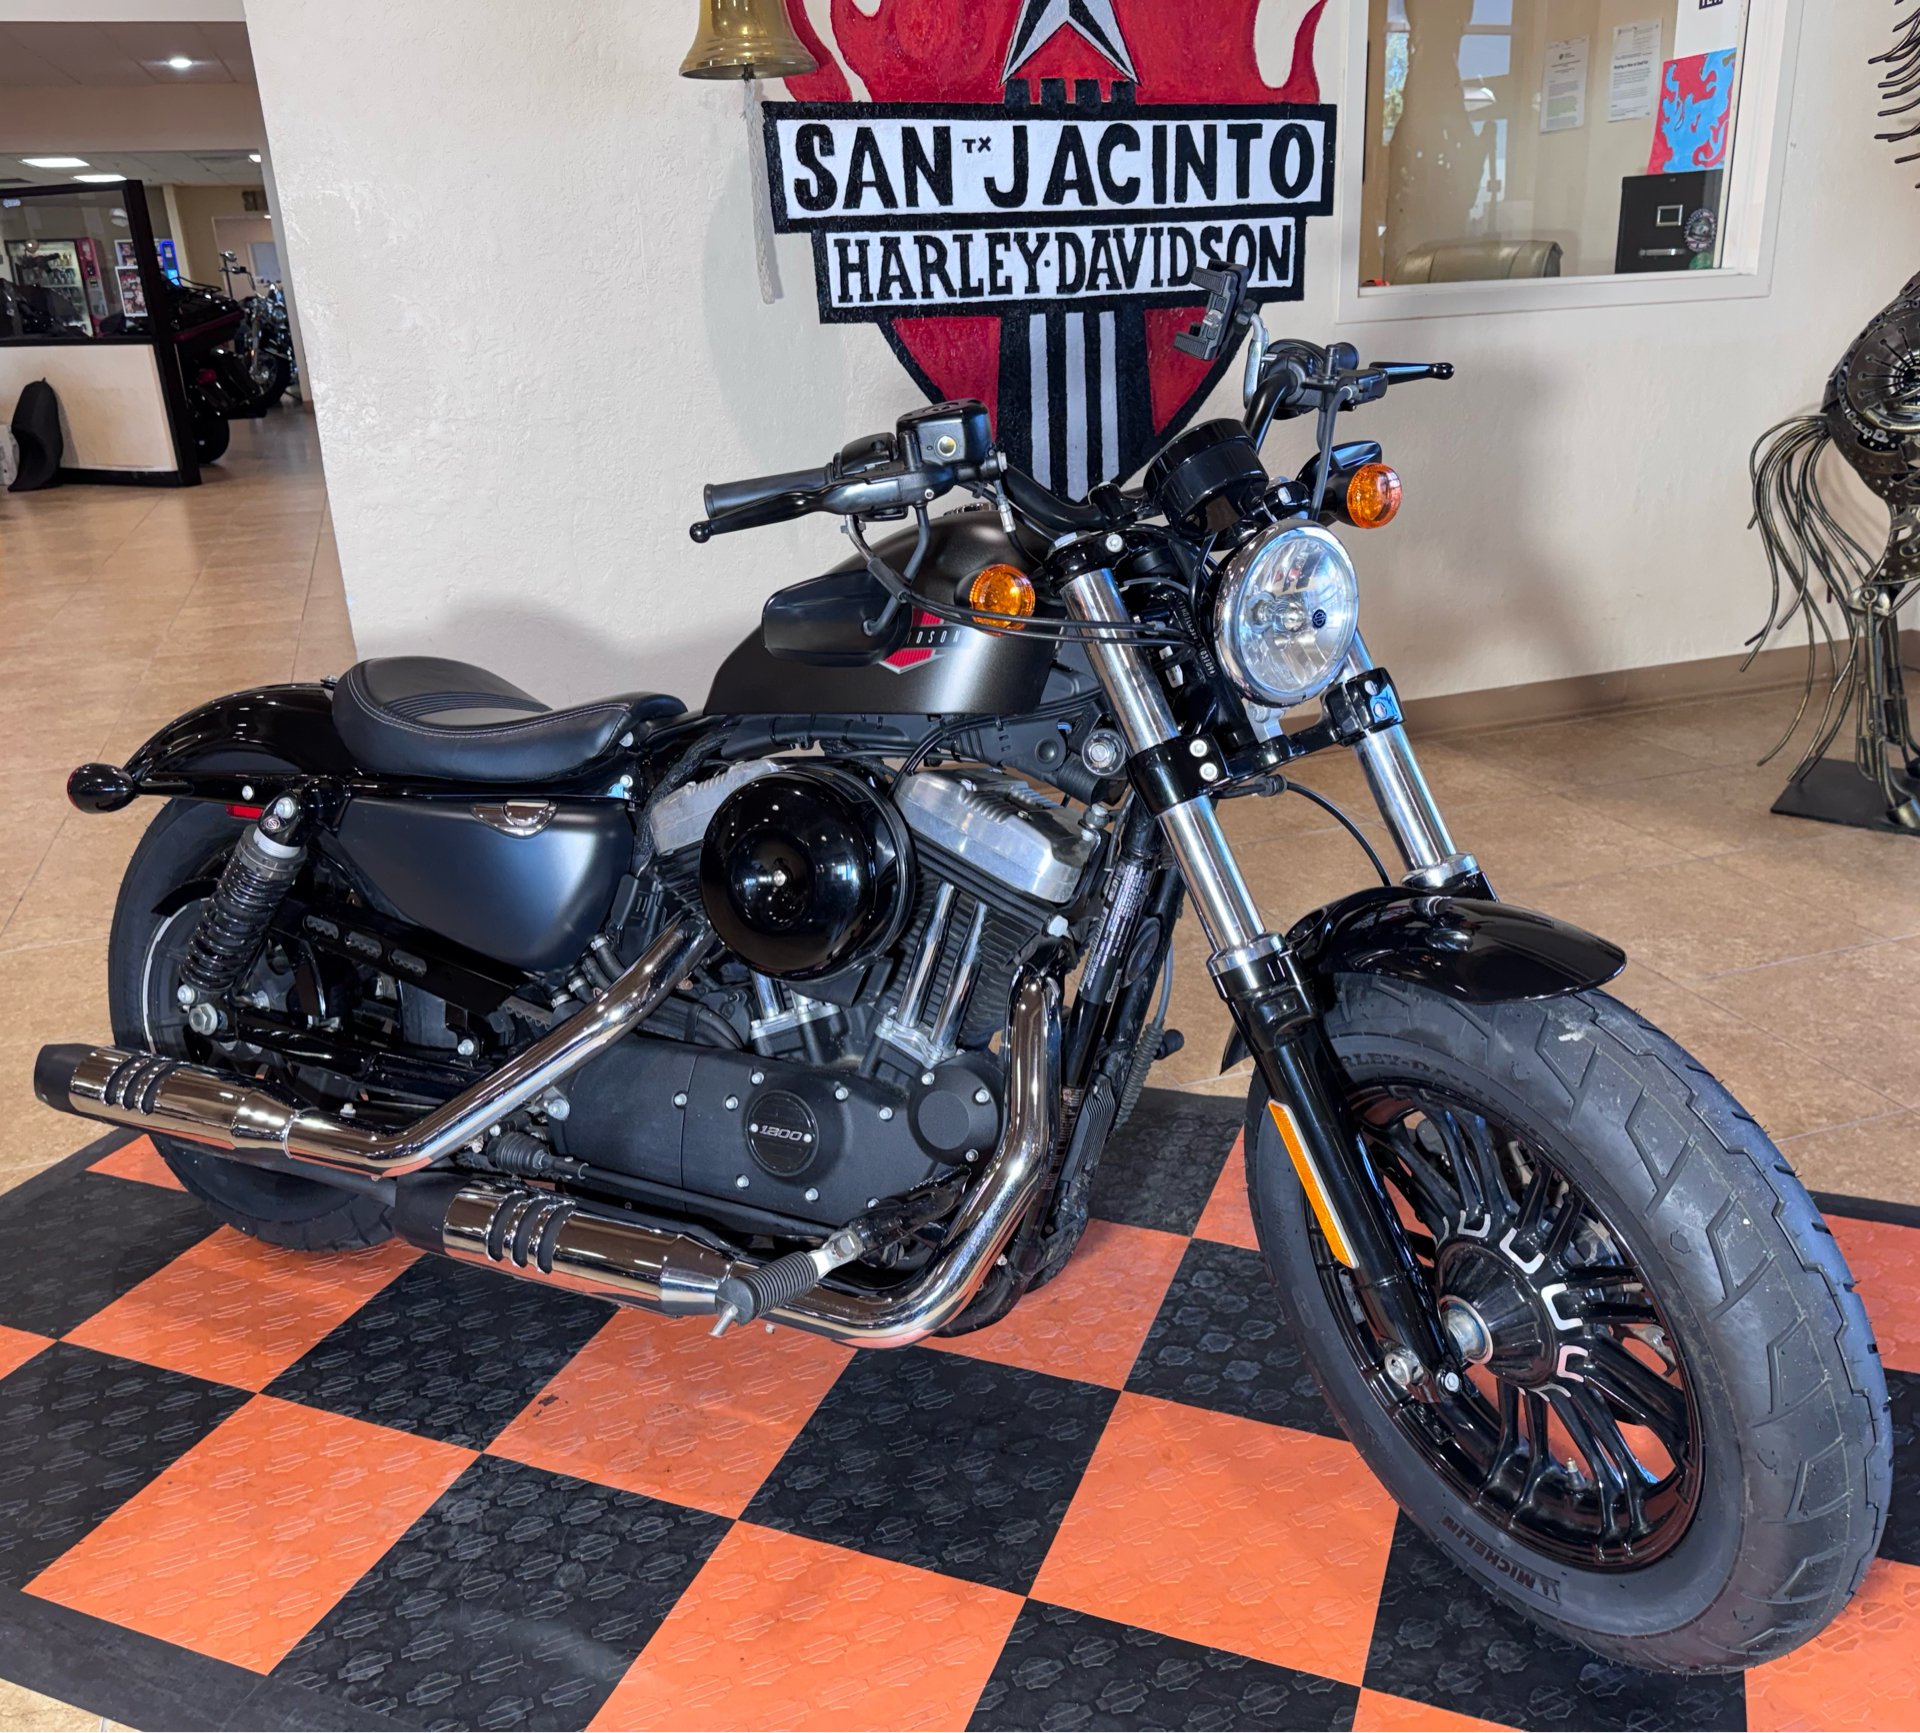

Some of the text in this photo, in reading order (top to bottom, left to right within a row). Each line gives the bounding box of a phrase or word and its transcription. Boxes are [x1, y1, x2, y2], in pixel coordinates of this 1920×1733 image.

[794, 122, 1315, 211] SAN TX JACINTO
[760, 1125, 803, 1141] 1200
[1441, 1515, 1536, 1589] MICHELIN
